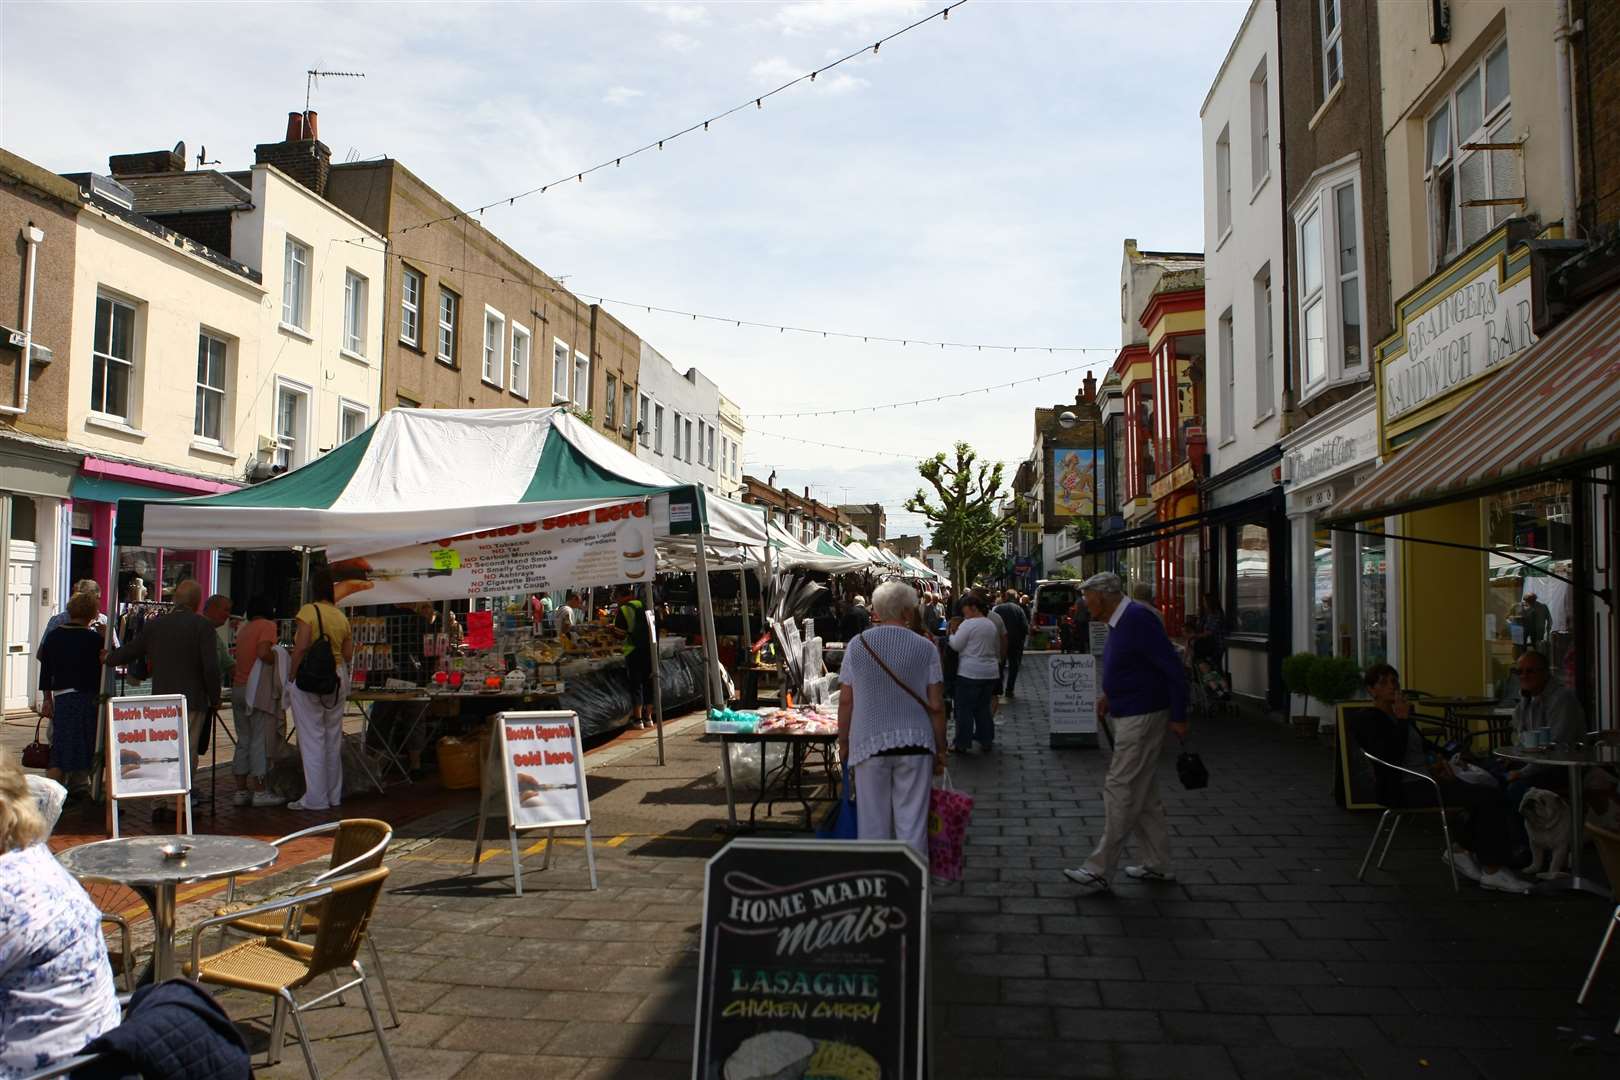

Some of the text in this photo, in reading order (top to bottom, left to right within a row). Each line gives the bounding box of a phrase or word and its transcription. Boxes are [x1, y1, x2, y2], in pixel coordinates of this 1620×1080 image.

[1408, 280, 1498, 362] GRAINGERS
[1386, 299, 1537, 417] SANDWICH BAR
[494, 540, 530, 549] Tobacco
[474, 560, 505, 568] Second
[531, 555, 558, 563] Smoke
[479, 554, 509, 562] Carbon
[511, 550, 552, 558] Monoxide
[516, 562, 547, 571] Clothes
[486, 578, 523, 586] Cigarette
[525, 575, 546, 583] Butts
[498, 571, 535, 579] Ashtrays
[482, 585, 521, 594] Smoker's
[523, 581, 551, 589] Cough
[728, 877, 888, 924] HOME MADE
[731, 967, 879, 997] LASAGNE
[722, 999, 808, 1018] CHICKEN
